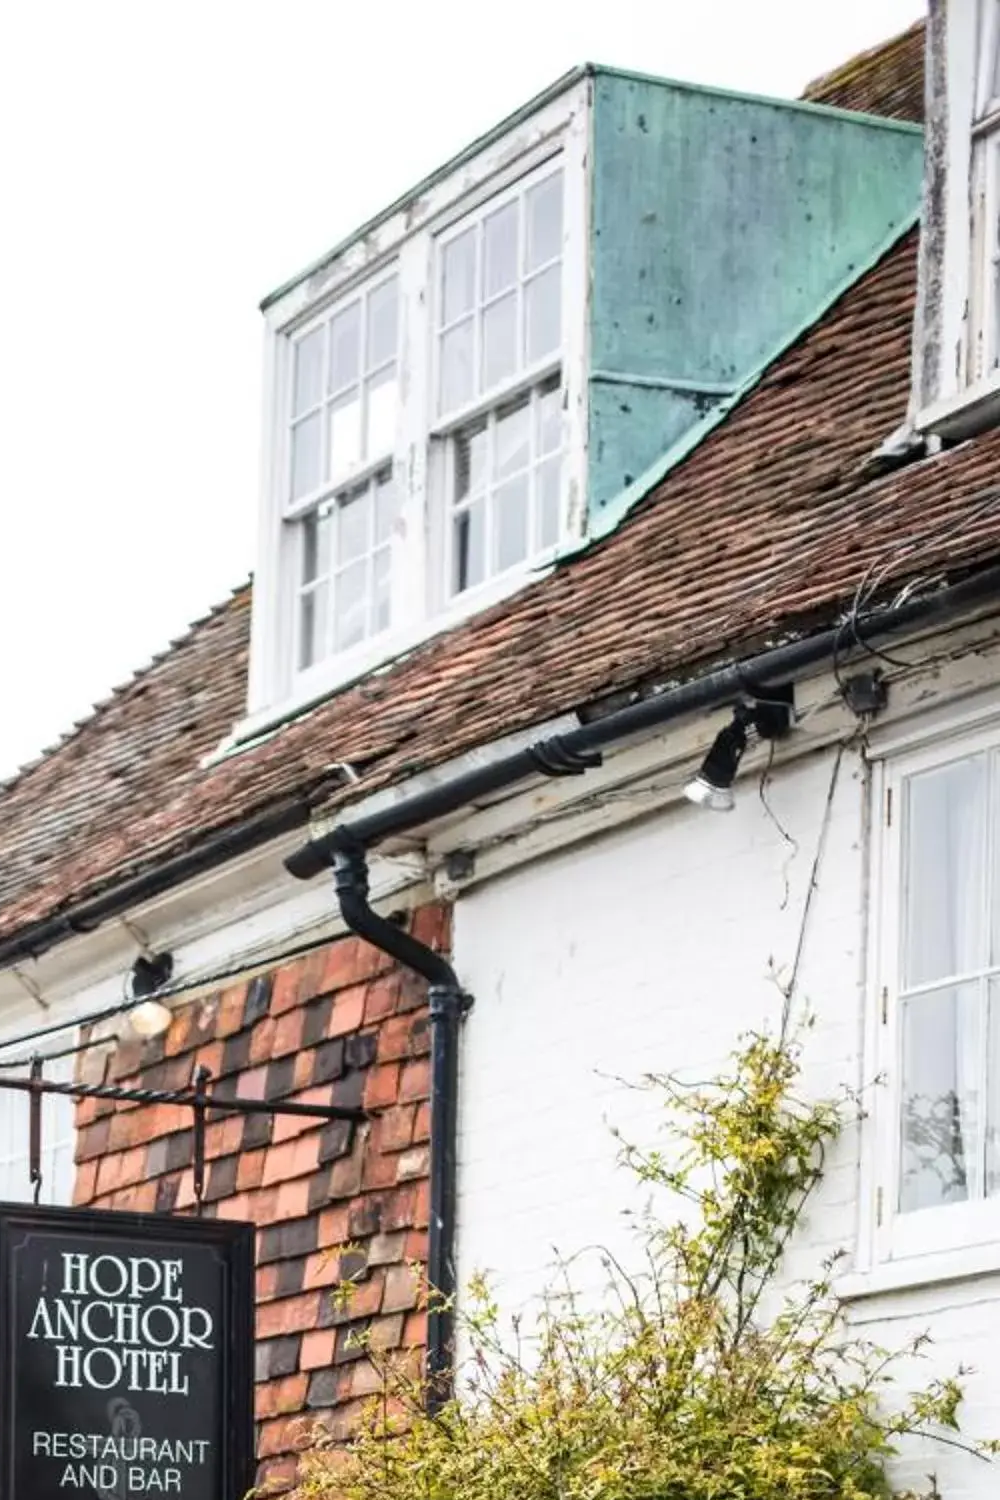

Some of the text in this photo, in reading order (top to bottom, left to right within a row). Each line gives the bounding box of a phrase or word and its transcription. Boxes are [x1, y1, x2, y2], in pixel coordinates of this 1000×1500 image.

[61, 1253, 183, 1303] HOPE
[27, 1297, 214, 1349] ANCHOR
[54, 1346, 189, 1395] HOTEL
[33, 1432, 210, 1464] RESTAURANT
[60, 1465, 182, 1493] AND BAR
